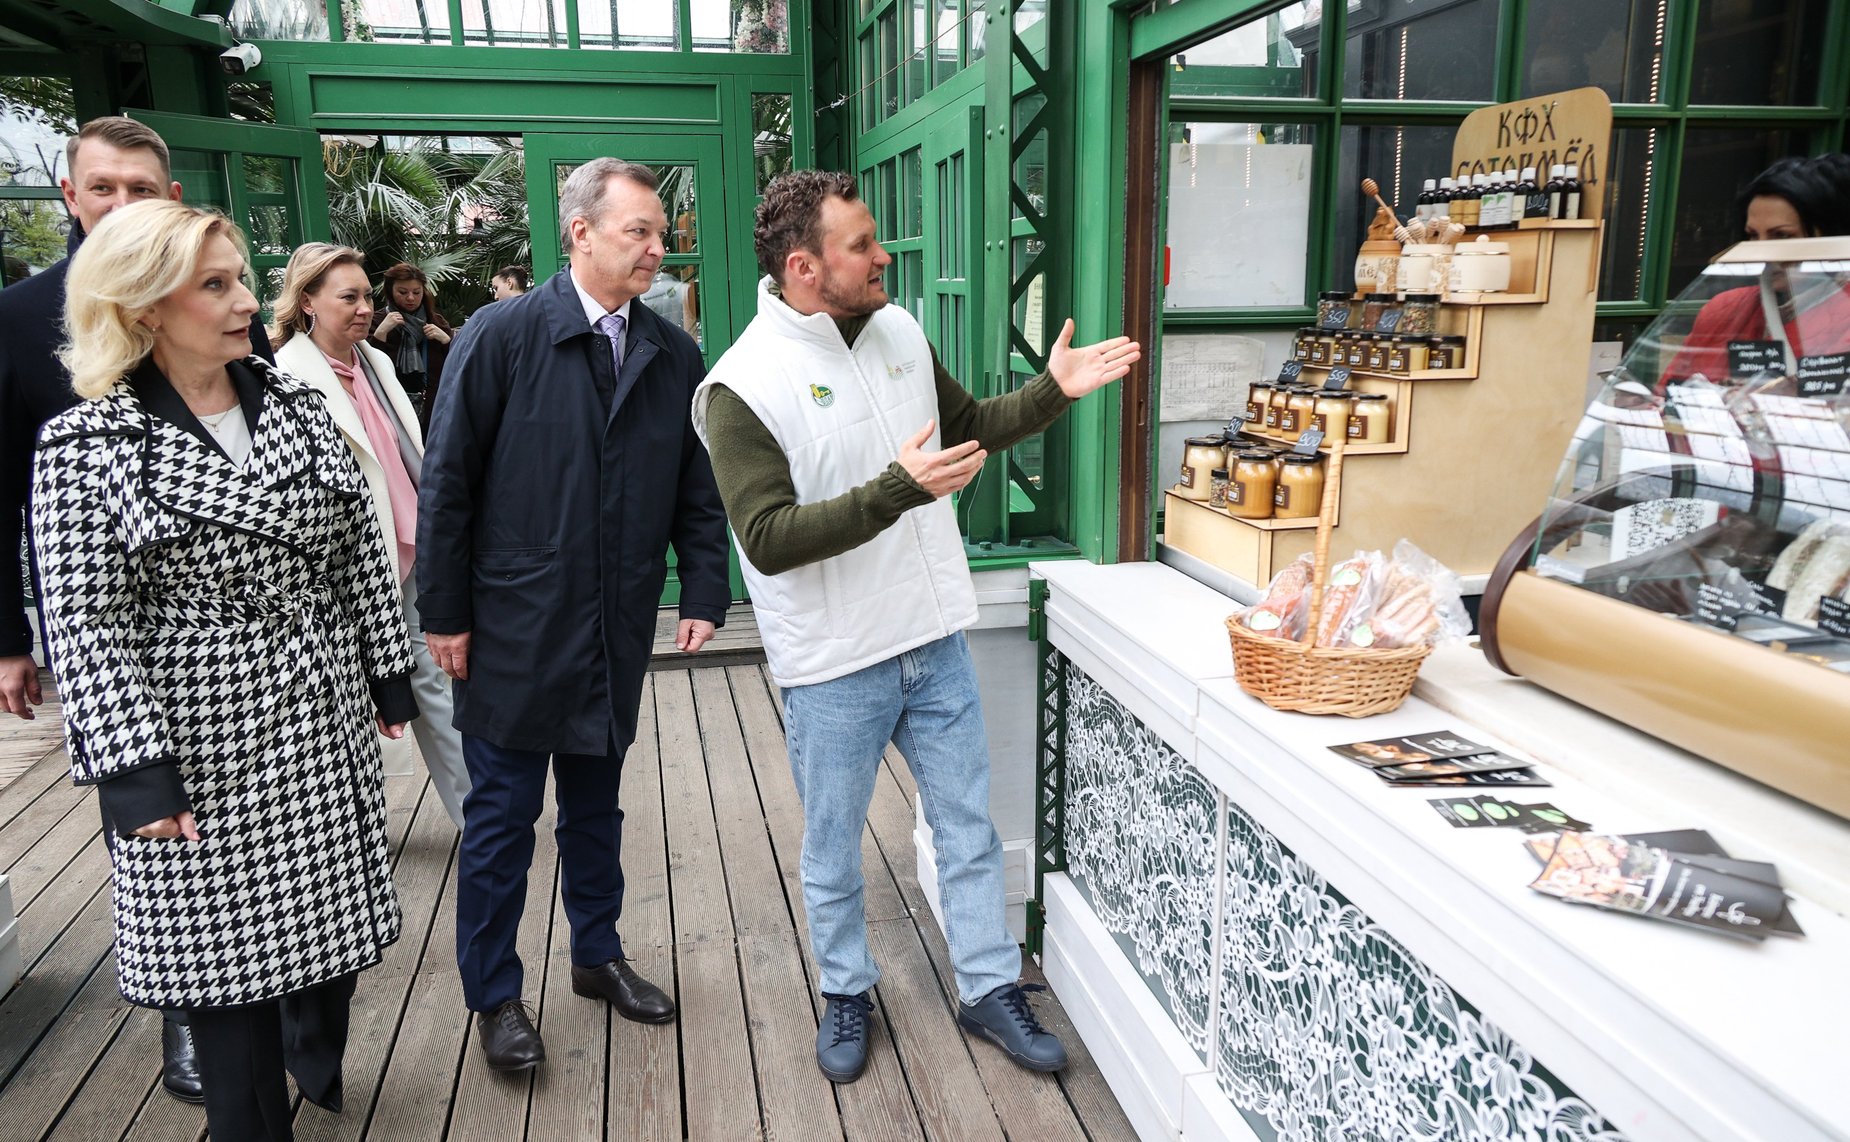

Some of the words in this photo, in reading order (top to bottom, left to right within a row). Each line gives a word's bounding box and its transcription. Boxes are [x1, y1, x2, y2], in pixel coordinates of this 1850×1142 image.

[1497, 101, 1557, 149] КФХ
[1324, 309, 1349, 324] 350
[1328, 369, 1348, 382] 550
[1299, 432, 1323, 448] 900
